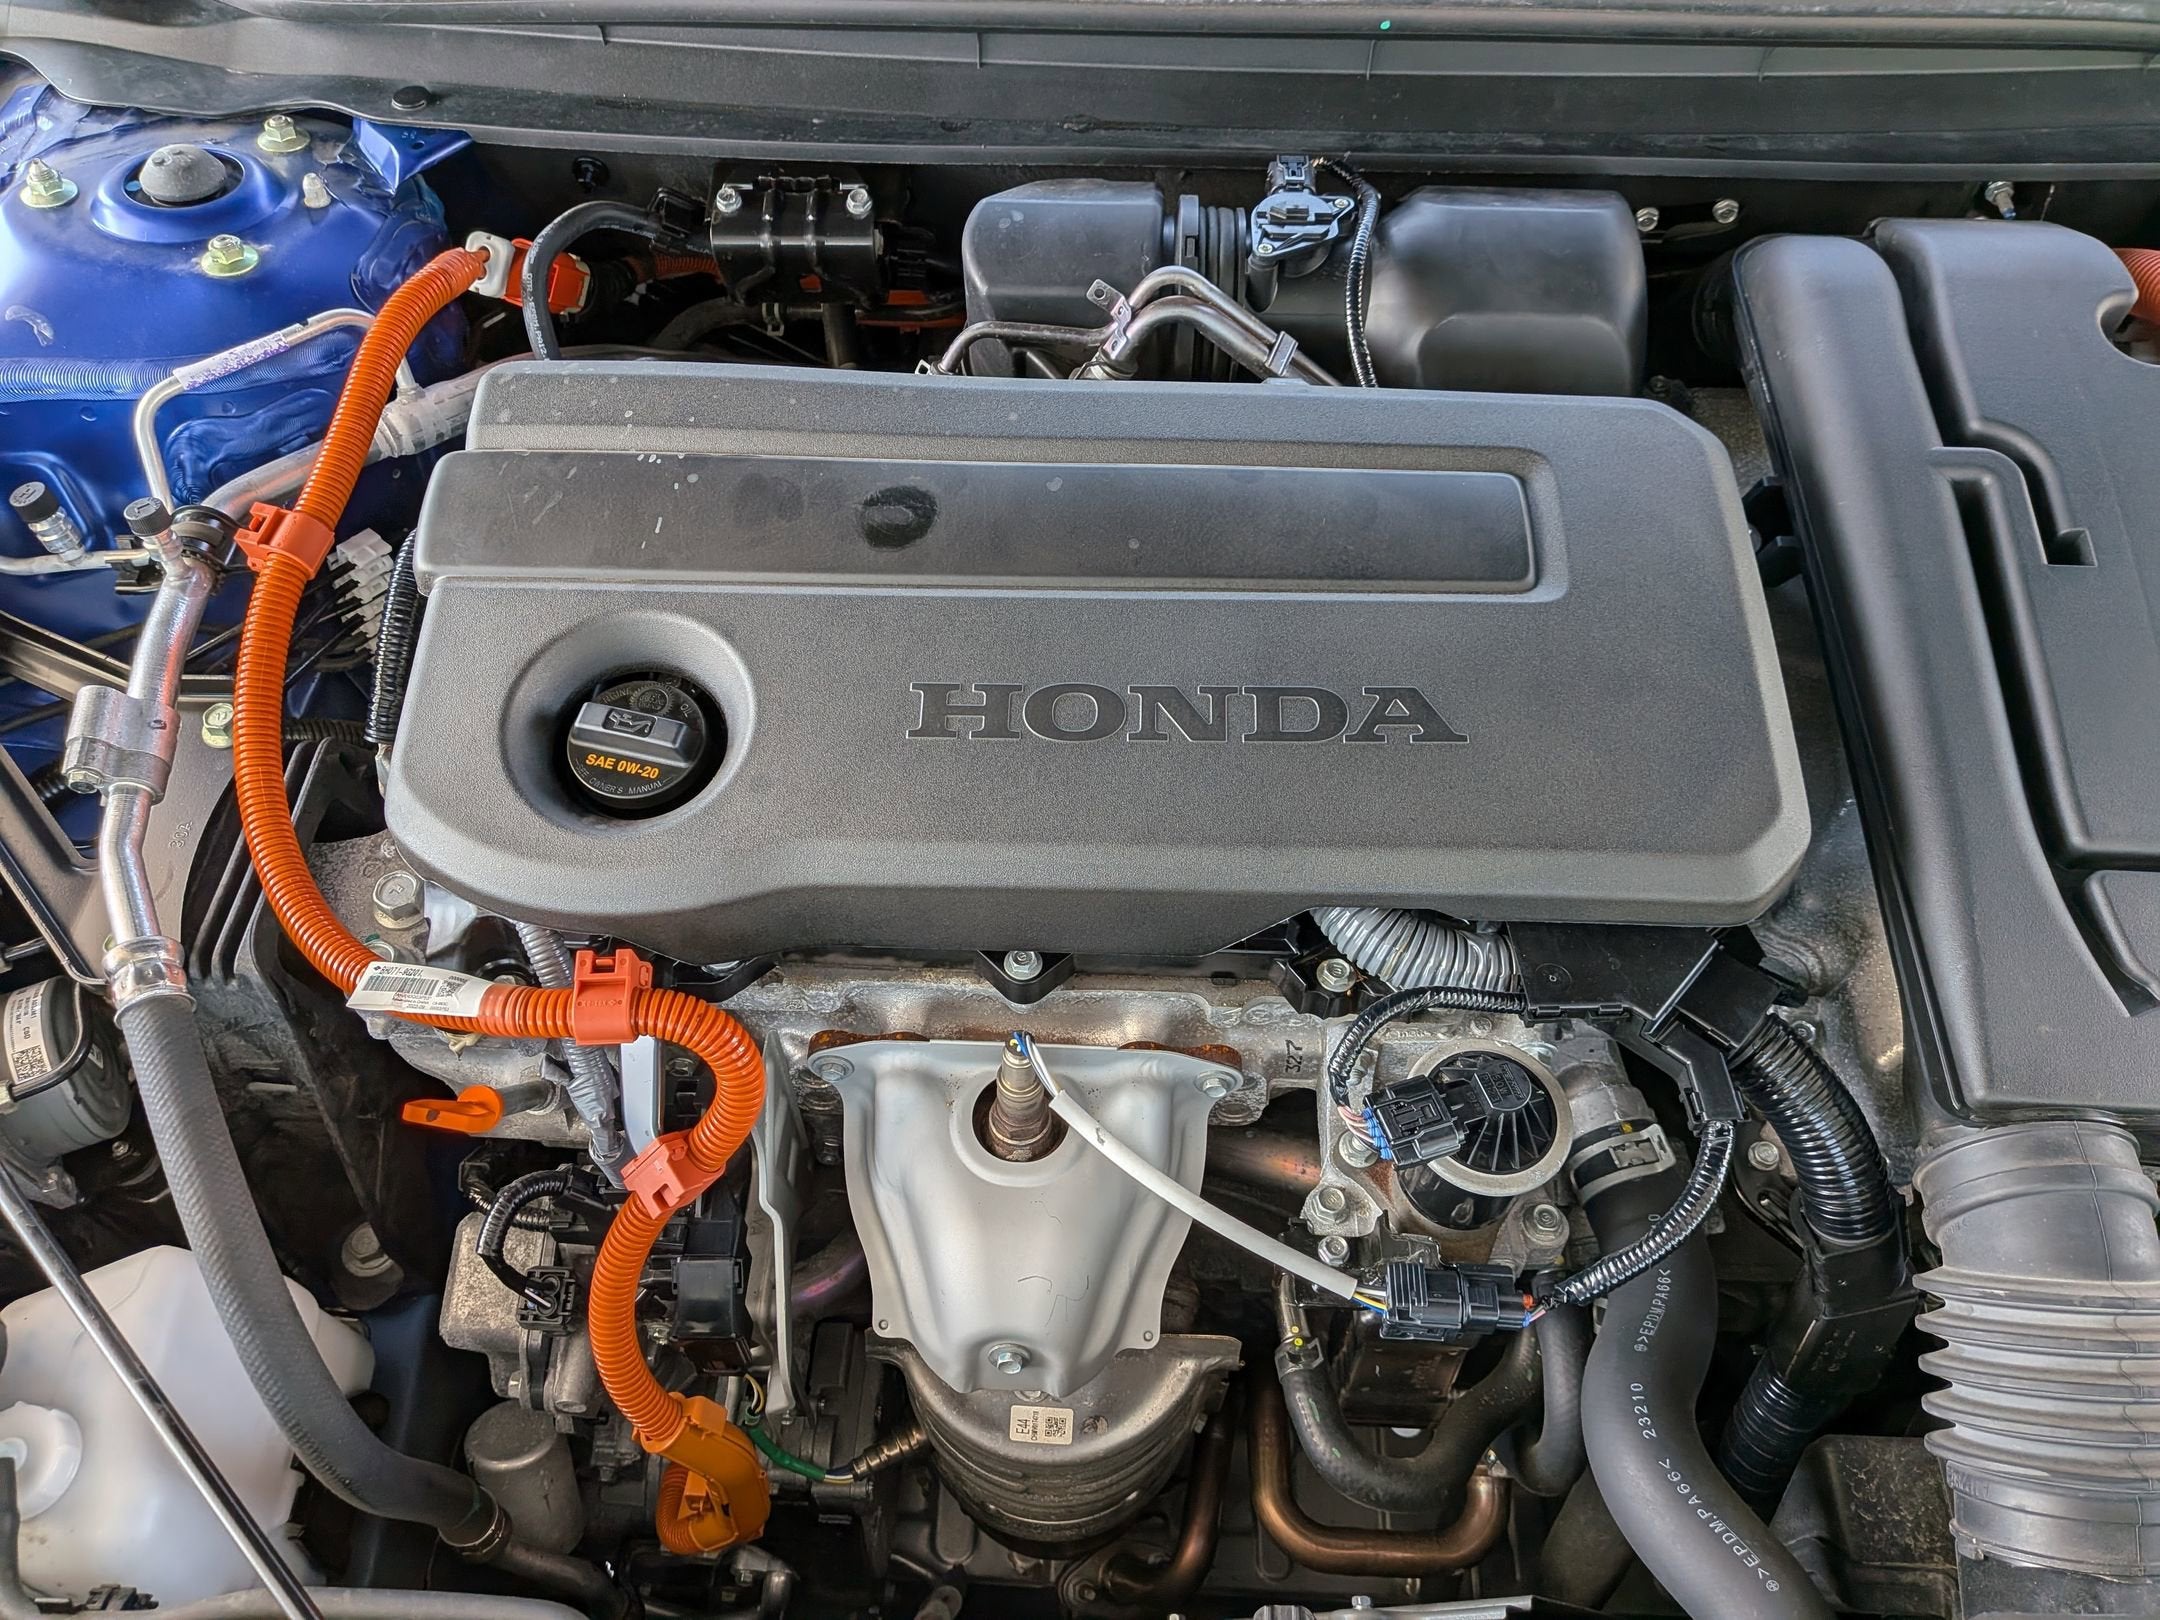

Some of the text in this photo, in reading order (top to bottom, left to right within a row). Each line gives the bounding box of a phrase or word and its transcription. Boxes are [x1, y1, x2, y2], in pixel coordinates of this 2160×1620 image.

[906, 682, 1470, 743] HONDA
[585, 754, 660, 779] SAE 0W-20
[589, 777, 623, 794] OWNER'S
[628, 780, 662, 795] MANUAL
[1285, 1039, 1303, 1073] 327
[1630, 1382, 1657, 1440] 23210
[1015, 1418, 1031, 1434] E44
